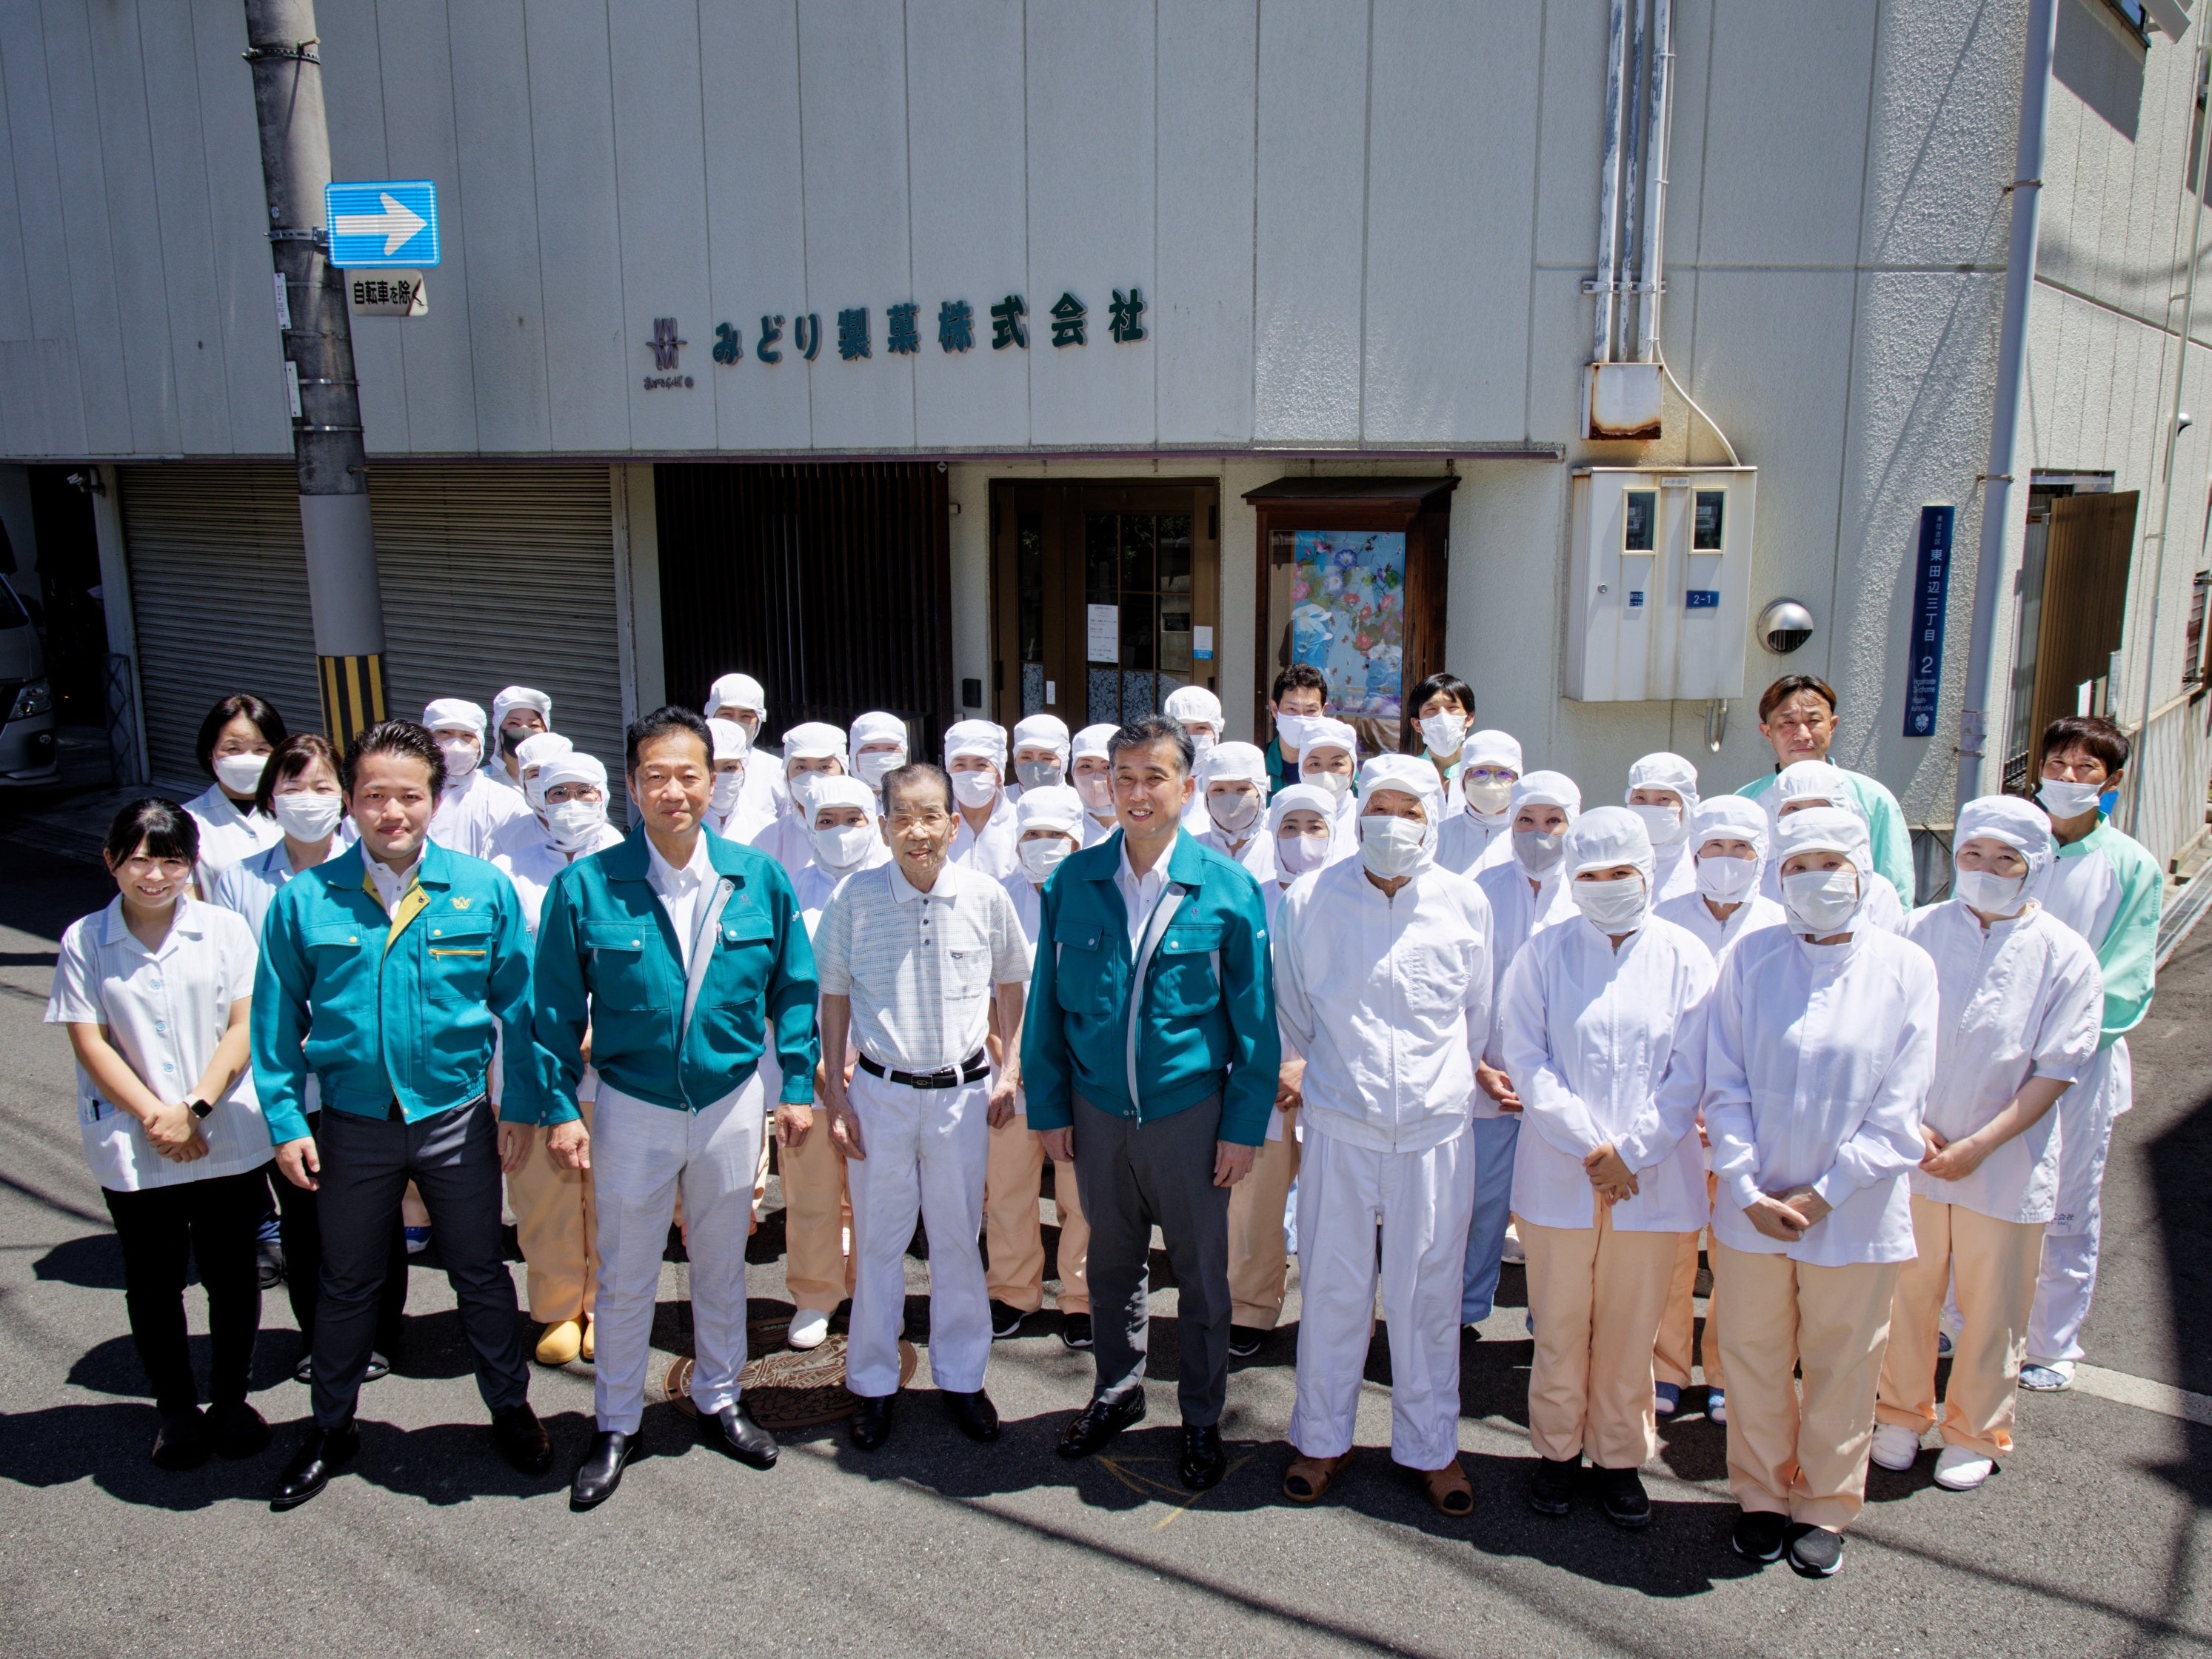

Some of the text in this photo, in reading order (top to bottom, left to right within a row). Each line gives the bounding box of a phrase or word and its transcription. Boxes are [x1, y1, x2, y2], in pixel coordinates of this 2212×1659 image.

[353, 280, 424, 307] 自転車を除く
[712, 288, 1149, 366] みどり製菓株式会社
[1694, 595, 1711, 604] 2-1
[1924, 549, 1942, 642] 東田辺三丁目
[1921, 656, 1933, 673] 2
